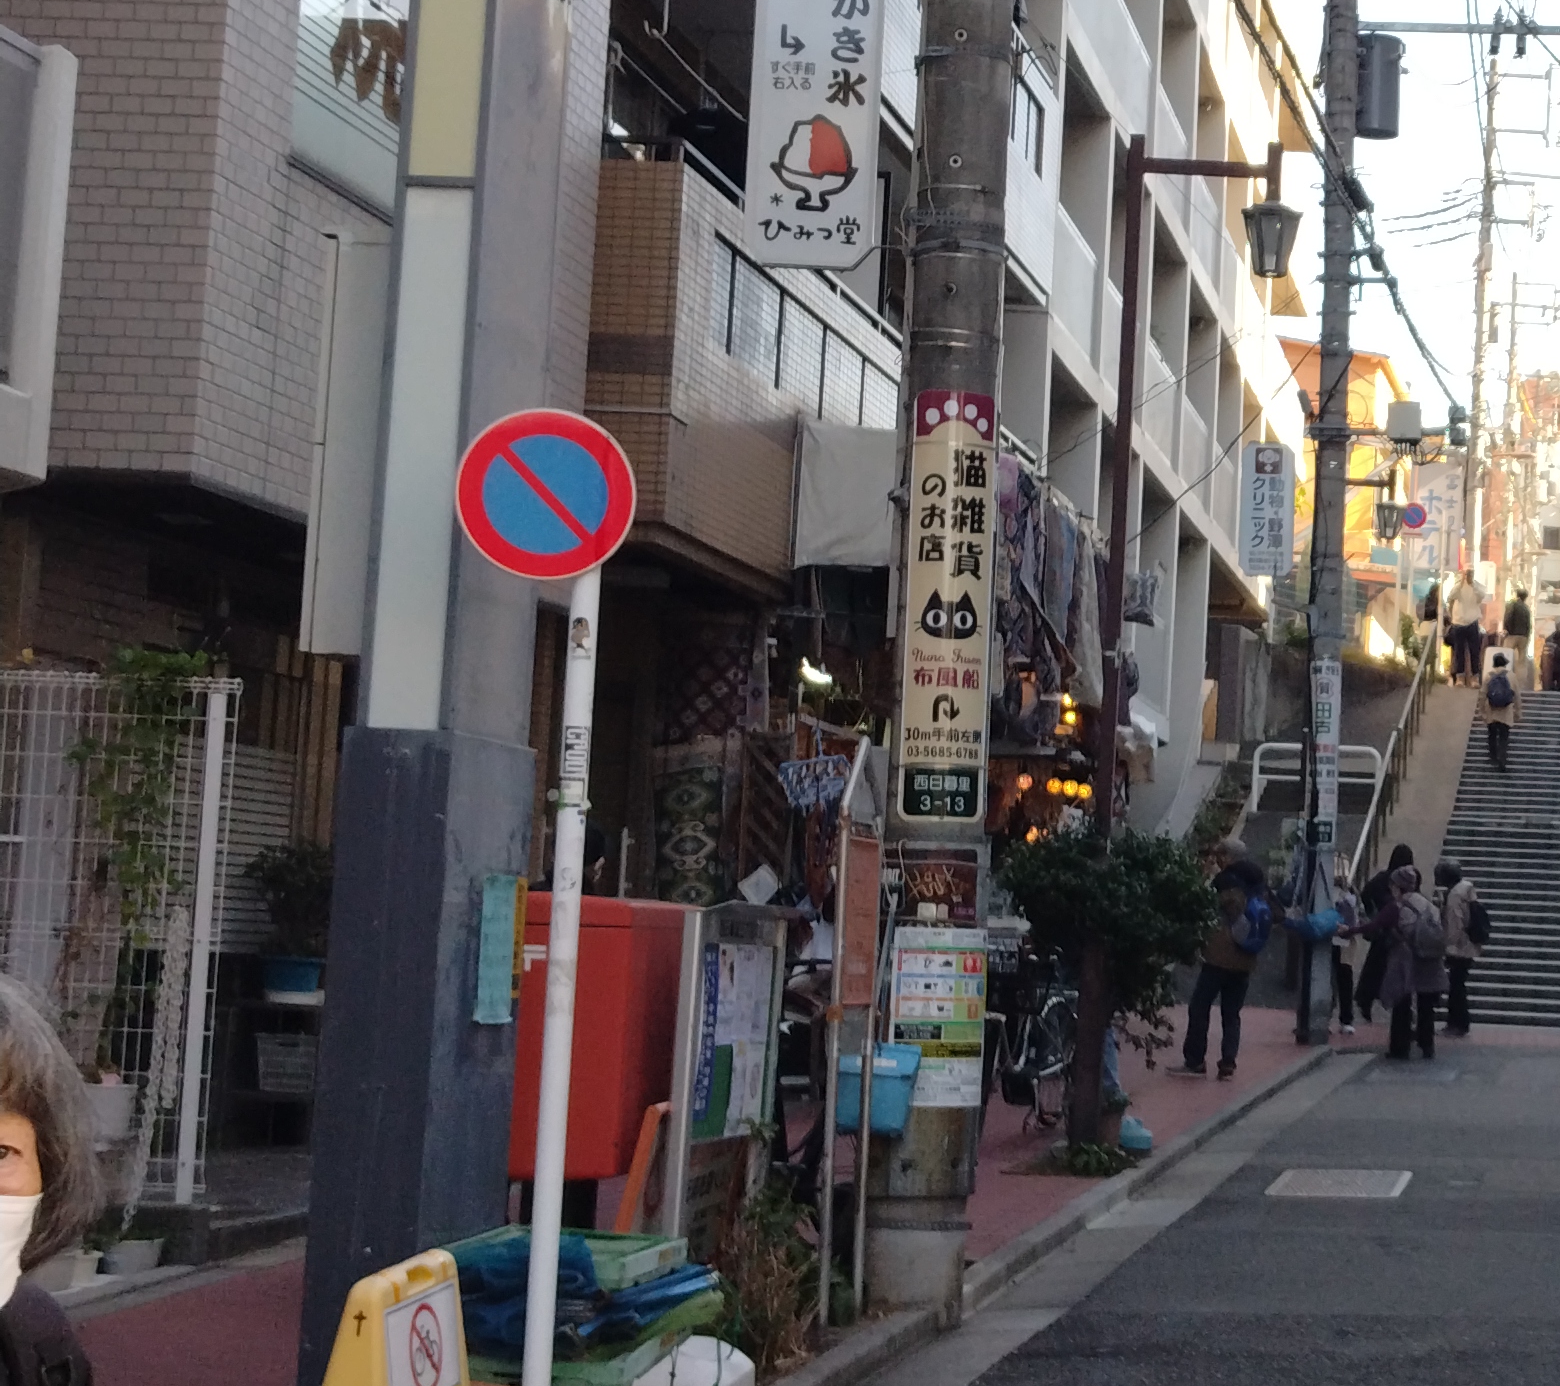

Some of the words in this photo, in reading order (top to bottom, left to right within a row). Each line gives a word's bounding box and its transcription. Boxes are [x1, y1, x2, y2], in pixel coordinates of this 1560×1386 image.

[769, 60, 817, 77] すぐ手前
[772, 76, 813, 92] 右入る
[757, 214, 861, 246] ひみつ堂
[918, 472, 947, 564] のお店
[948, 448, 988, 581] 猫雑貨
[1251, 476, 1266, 549] クリニック
[911, 647, 945, 663] Nuno
[913, 666, 980, 690] 布風船
[913, 774, 971, 792] 西日暮里
[919, 795, 966, 812] 3-13
